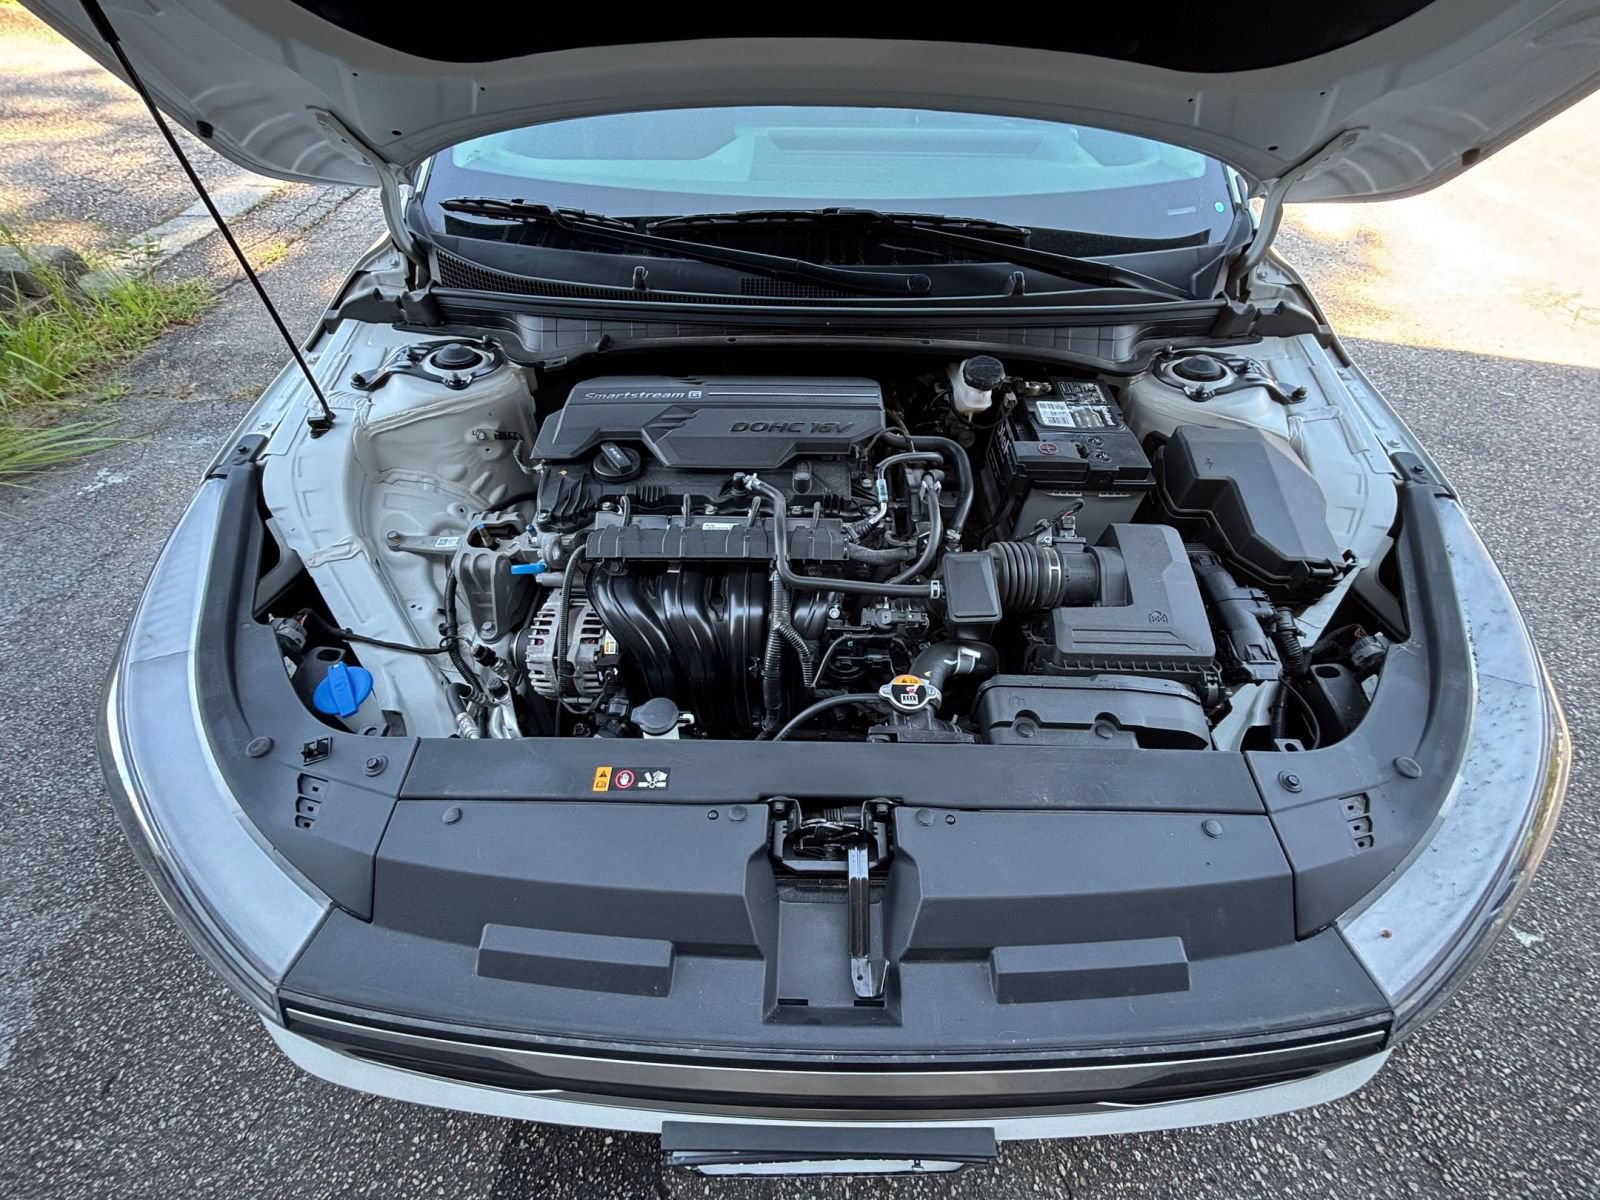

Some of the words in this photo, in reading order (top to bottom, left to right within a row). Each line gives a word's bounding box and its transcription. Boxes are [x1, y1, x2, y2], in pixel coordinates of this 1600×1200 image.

[584, 391, 685, 400] Smartstream
[729, 421, 806, 433] DOHC
[810, 421, 854, 433] 16V
